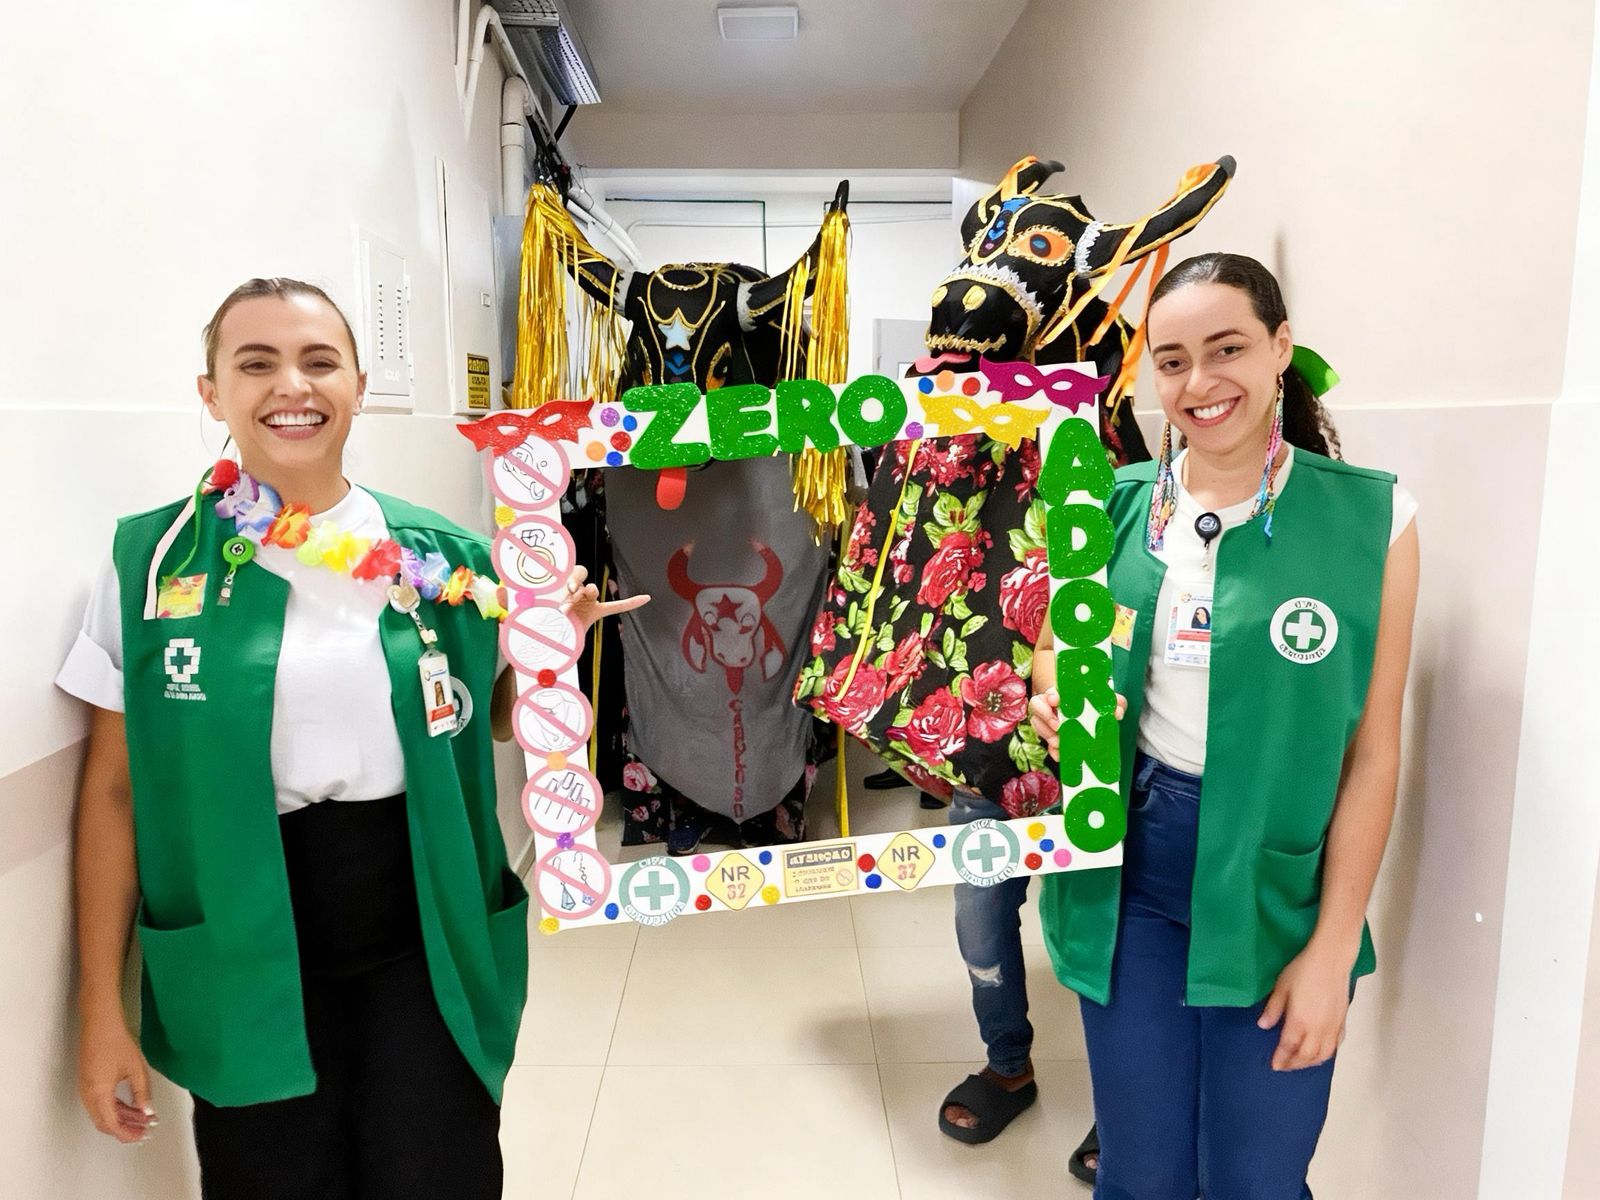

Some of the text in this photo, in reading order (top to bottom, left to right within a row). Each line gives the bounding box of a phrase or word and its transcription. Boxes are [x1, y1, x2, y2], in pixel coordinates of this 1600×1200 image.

[622, 375, 907, 470] ZERO
[1038, 418, 1127, 853] ADORNO
[892, 845, 921, 863] NR
[721, 865, 751, 883] NR
[897, 863, 917, 881] 32
[727, 883, 747, 901] 32
